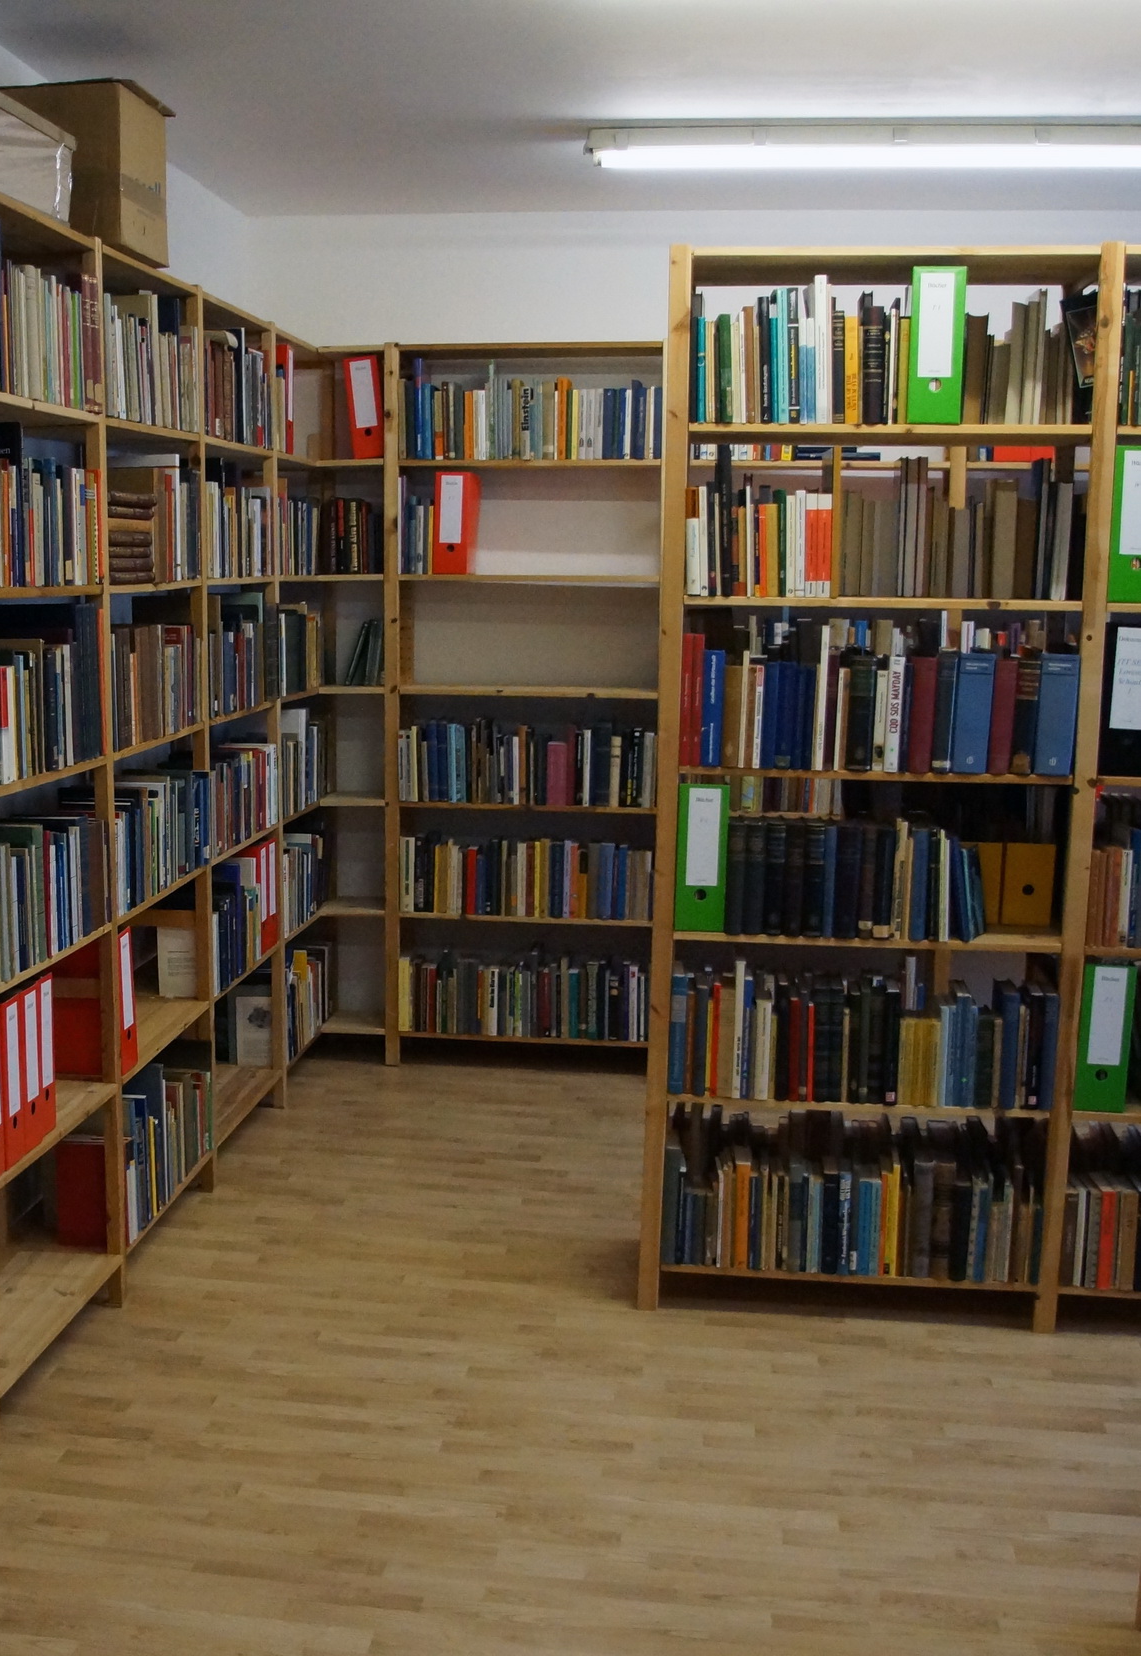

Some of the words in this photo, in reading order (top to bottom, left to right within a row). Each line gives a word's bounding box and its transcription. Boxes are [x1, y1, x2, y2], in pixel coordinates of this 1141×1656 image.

[520, 388, 530, 432] Einstein
[348, 501, 357, 526] Edison
[349, 527, 357, 543] Alva
[349, 544, 358, 572] Thomas
[891, 670, 902, 700] MAYDAY
[890, 702, 900, 716] SOS
